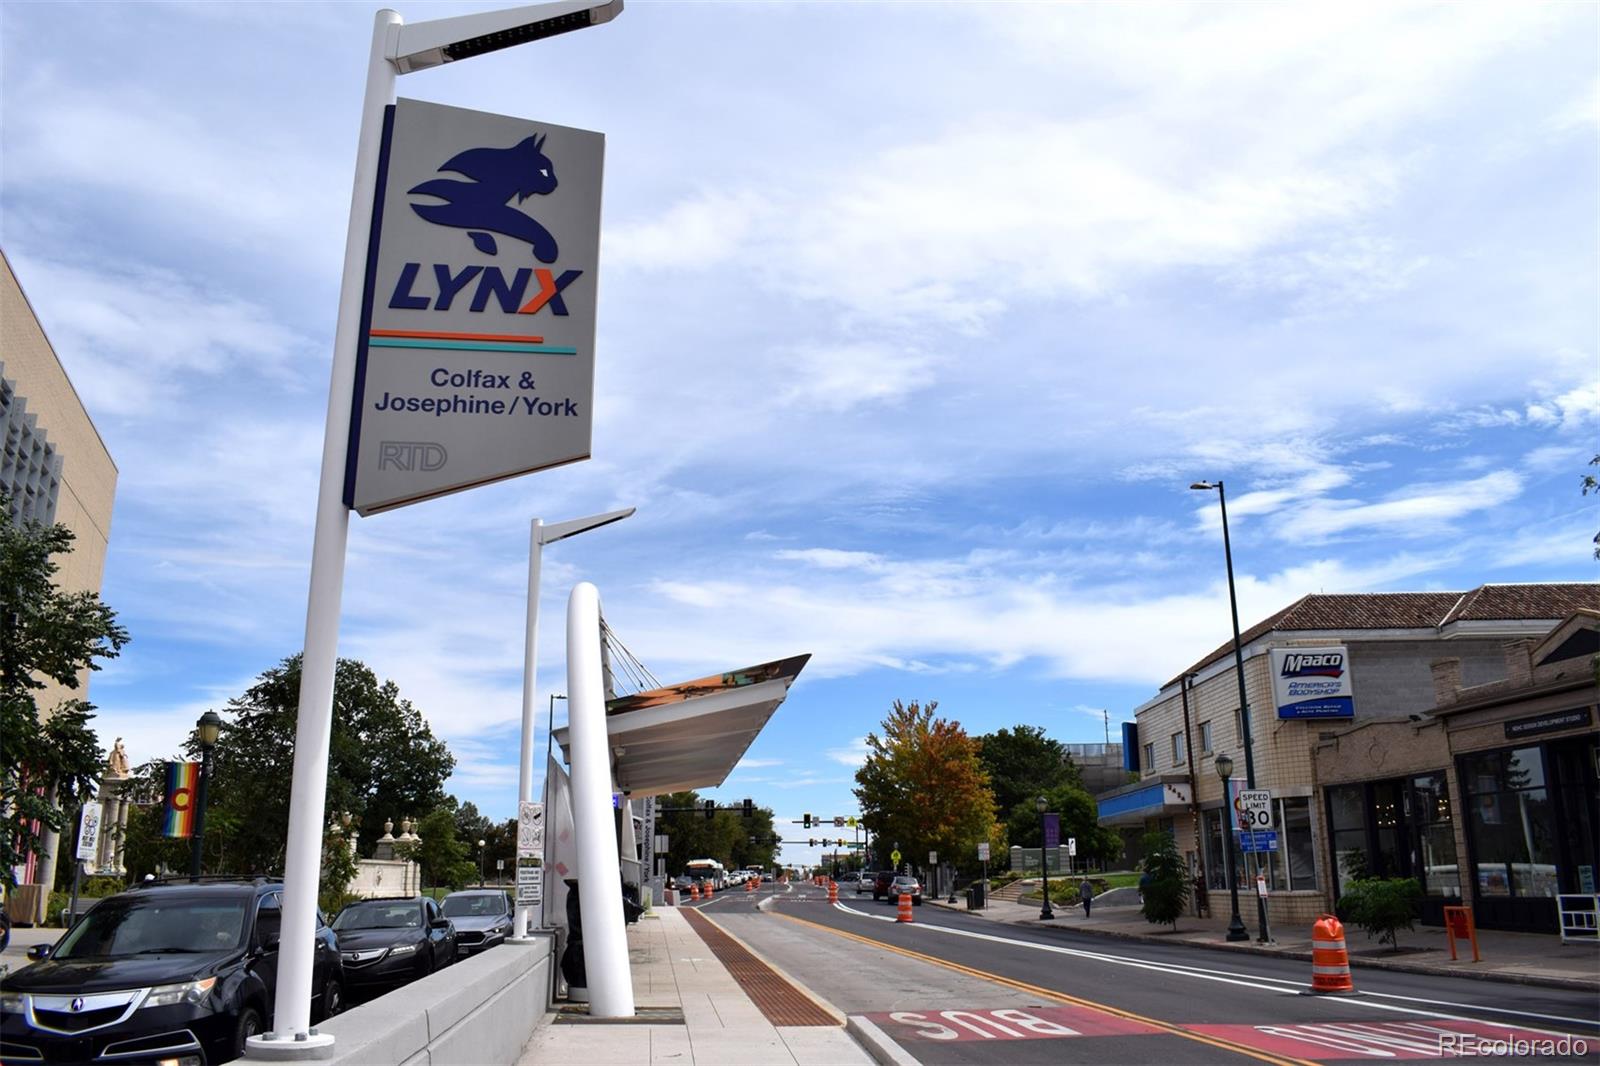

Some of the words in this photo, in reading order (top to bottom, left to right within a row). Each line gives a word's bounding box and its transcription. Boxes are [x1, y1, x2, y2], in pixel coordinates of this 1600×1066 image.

[388, 262, 584, 316] LYNX
[430, 367, 511, 390] Colfax
[518, 371, 536, 390] &
[377, 440, 448, 472] RTD
[1284, 654, 1343, 673] Maaco
[1242, 793, 1269, 801] SPEED
[889, 1009, 1083, 1040] BUS
